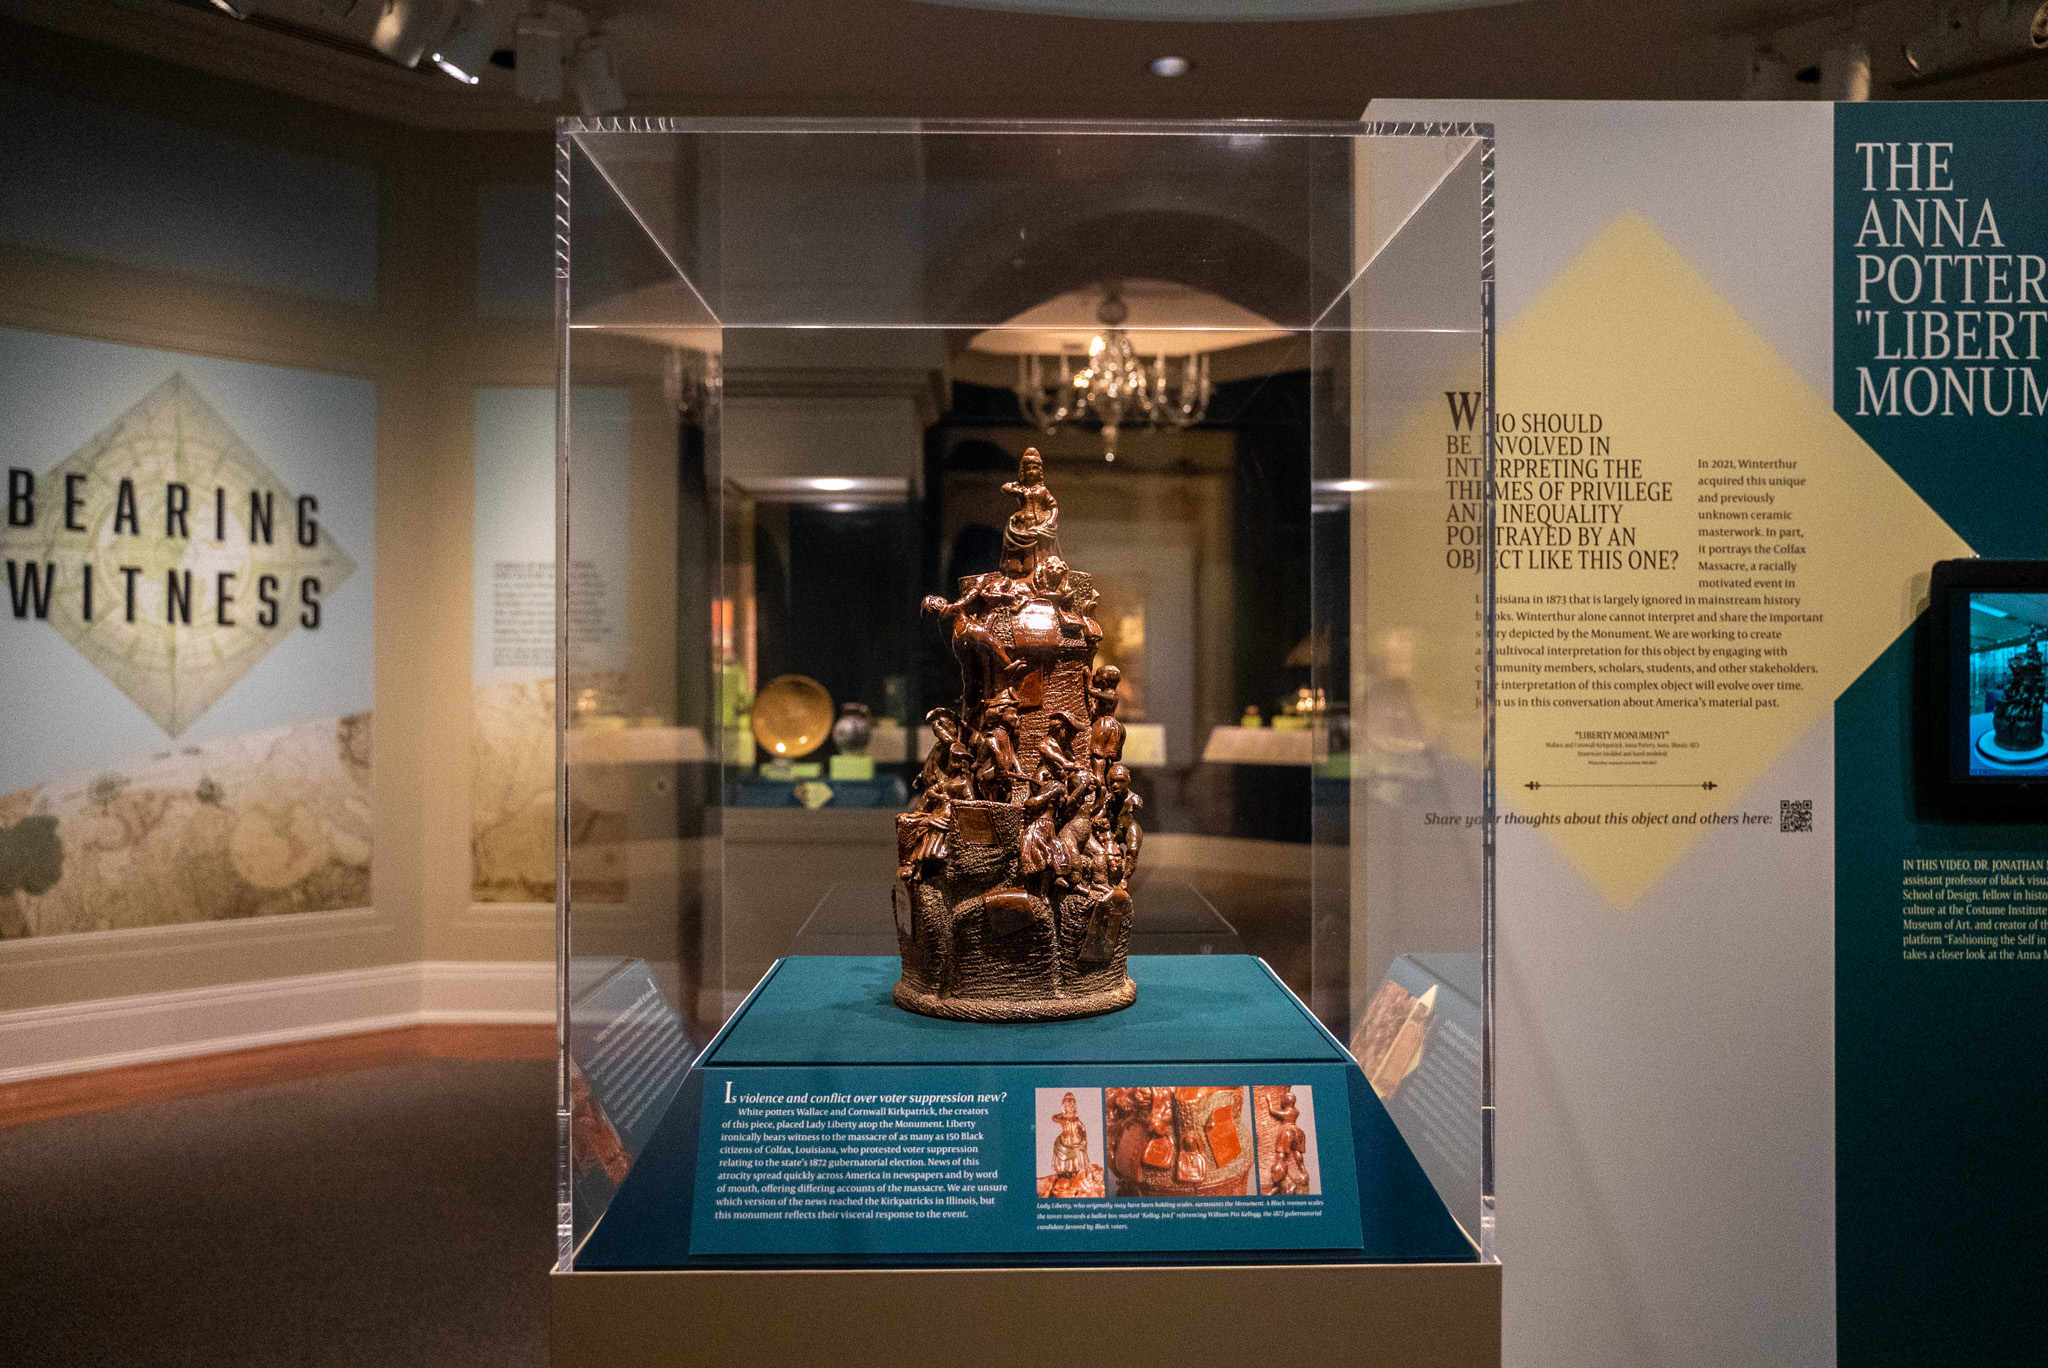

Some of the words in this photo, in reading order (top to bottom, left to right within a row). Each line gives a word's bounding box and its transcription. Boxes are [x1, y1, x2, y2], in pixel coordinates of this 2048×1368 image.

[1856, 142, 1953, 191] THE
[1853, 198, 2005, 248] ANNA
[1856, 254, 2048, 304] POTTER
[1522, 413, 1603, 433] SHOULD
[1447, 435, 1472, 454] BE
[1590, 436, 1611, 456] IN
[1447, 458, 1598, 478] INTRPRETING
[1603, 459, 1642, 479] THE
[1698, 459, 1709, 469] In
[1738, 459, 1797, 469] Winterthur
[1698, 476, 1744, 489] acquired
[1746, 476, 1767, 486] this
[1768, 476, 1806, 489] unique
[1538, 481, 1564, 501] OF
[1571, 482, 1672, 502] PRIVILEGE
[1698, 493, 1718, 503] and
[1720, 493, 1775, 506] previously
[8, 467, 320, 547] BEARING
[1503, 504, 1623, 525] INEQUALITY
[1698, 510, 1748, 520] unknown
[1750, 510, 1792, 520] ceramic
[1578, 527, 1606, 546] BY
[1608, 527, 1636, 546] AN
[1766, 527, 1777, 537] In
[1779, 527, 1804, 540] part,
[1698, 544, 1706, 554] it
[1708, 544, 1752, 557] portrays
[1754, 544, 1771, 554] the
[1773, 544, 1806, 554] Colfax
[1447, 549, 1523, 572] OBJCT
[1529, 550, 1572, 570] LIKE
[1578, 550, 1622, 570] THIS
[1628, 550, 1679, 570] ONE?
[1698, 561, 1748, 573] Massacre,
[1758, 561, 1797, 574] racially
[1698, 578, 1752, 588] motivated
[1753, 578, 1782, 588] event
[1784, 578, 1796, 588] in
[6, 560, 323, 630] WITNESS
[1532, 594, 1544, 604] in
[1546, 594, 1567, 604] 1873
[1568, 594, 1590, 605] that
[1592, 594, 1601, 605] is
[1603, 594, 1639, 608] largely
[1641, 594, 1682, 608] ignored
[1685, 594, 1696, 605] in
[1698, 594, 1761, 605] mainstream
[1763, 595, 1801, 608] history
[1516, 611, 1575, 622] Winterthur
[1578, 612, 1607, 622] alone
[1609, 612, 1645, 622] cannot
[1648, 612, 1695, 625] interpret
[1697, 612, 1718, 622] and
[1719, 612, 1748, 622] share
[1750, 612, 1768, 622] the
[1769, 612, 1823, 626] important
[1508, 628, 1555, 642] depicted
[1556, 628, 1570, 642] by
[1571, 628, 1589, 638] the
[1591, 628, 1652, 639] Monument.
[1654, 628, 1670, 639] We
[1691, 628, 1735, 642] working
[1737, 629, 1748, 639] to
[1750, 629, 1782, 639] create
[1424, 812, 1462, 825] Share
[1464, 815, 1501, 828] yor
[1503, 812, 1560, 828] thoughts
[1563, 812, 1600, 824] about
[1603, 812, 1628, 824] this
[1630, 812, 1667, 829] object
[1670, 812, 1696, 825] and
[1698, 812, 1738, 825] others
[1741, 812, 1772, 825] here:
[1903, 875, 1942, 886] assistant
[1945, 875, 1987, 888] professor
[1988, 875, 1999, 886] of
[2000, 875, 2025, 886] black
[1903, 890, 1933, 900] School
[1935, 890, 1945, 900] of
[1982, 890, 2011, 900] fellow
[2013, 890, 2023, 900] in
[1902, 904, 1936, 915] culture
[1937, 904, 1946, 915] at
[1948, 904, 1964, 915] the
[1966, 904, 2006, 915] Costume
[2008, 904, 2048, 915] Institute
[724, 1081, 736, 1104] Is
[738, 1093, 784, 1104] violence
[785, 1093, 807, 1104] and
[809, 1092, 850, 1103] conflict
[878, 1092, 906, 1103] voter
[908, 1092, 974, 1106] suppression
[976, 1092, 1007, 1103] new?
[738, 1107, 764, 1116] White
[764, 1107, 795, 1118] potters
[796, 1107, 828, 1116] Wallace
[830, 1107, 847, 1116] and
[848, 1107, 886, 1115] Cornwall
[938, 1107, 953, 1115] the
[954, 1106, 989, 1115] creators
[721, 1120, 731, 1129] of
[732, 1120, 749, 1129] this
[776, 1120, 805, 1131] placed
[806, 1120, 826, 1131] Lady
[827, 1120, 857, 1131] Liberty
[858, 1120, 878, 1131] atop
[879, 1120, 894, 1128] the
[946, 1119, 976, 1130] Liberty
[721, 1132, 762, 1144] ironically
[763, 1132, 786, 1141] bears
[787, 1132, 820, 1141] witness
[821, 1132, 831, 1141] to
[832, 1132, 847, 1141] the
[888, 1132, 898, 1141] of
[910, 1134, 934, 1143] many
[946, 1132, 960, 1140] 150
[961, 1132, 984, 1140] Black
